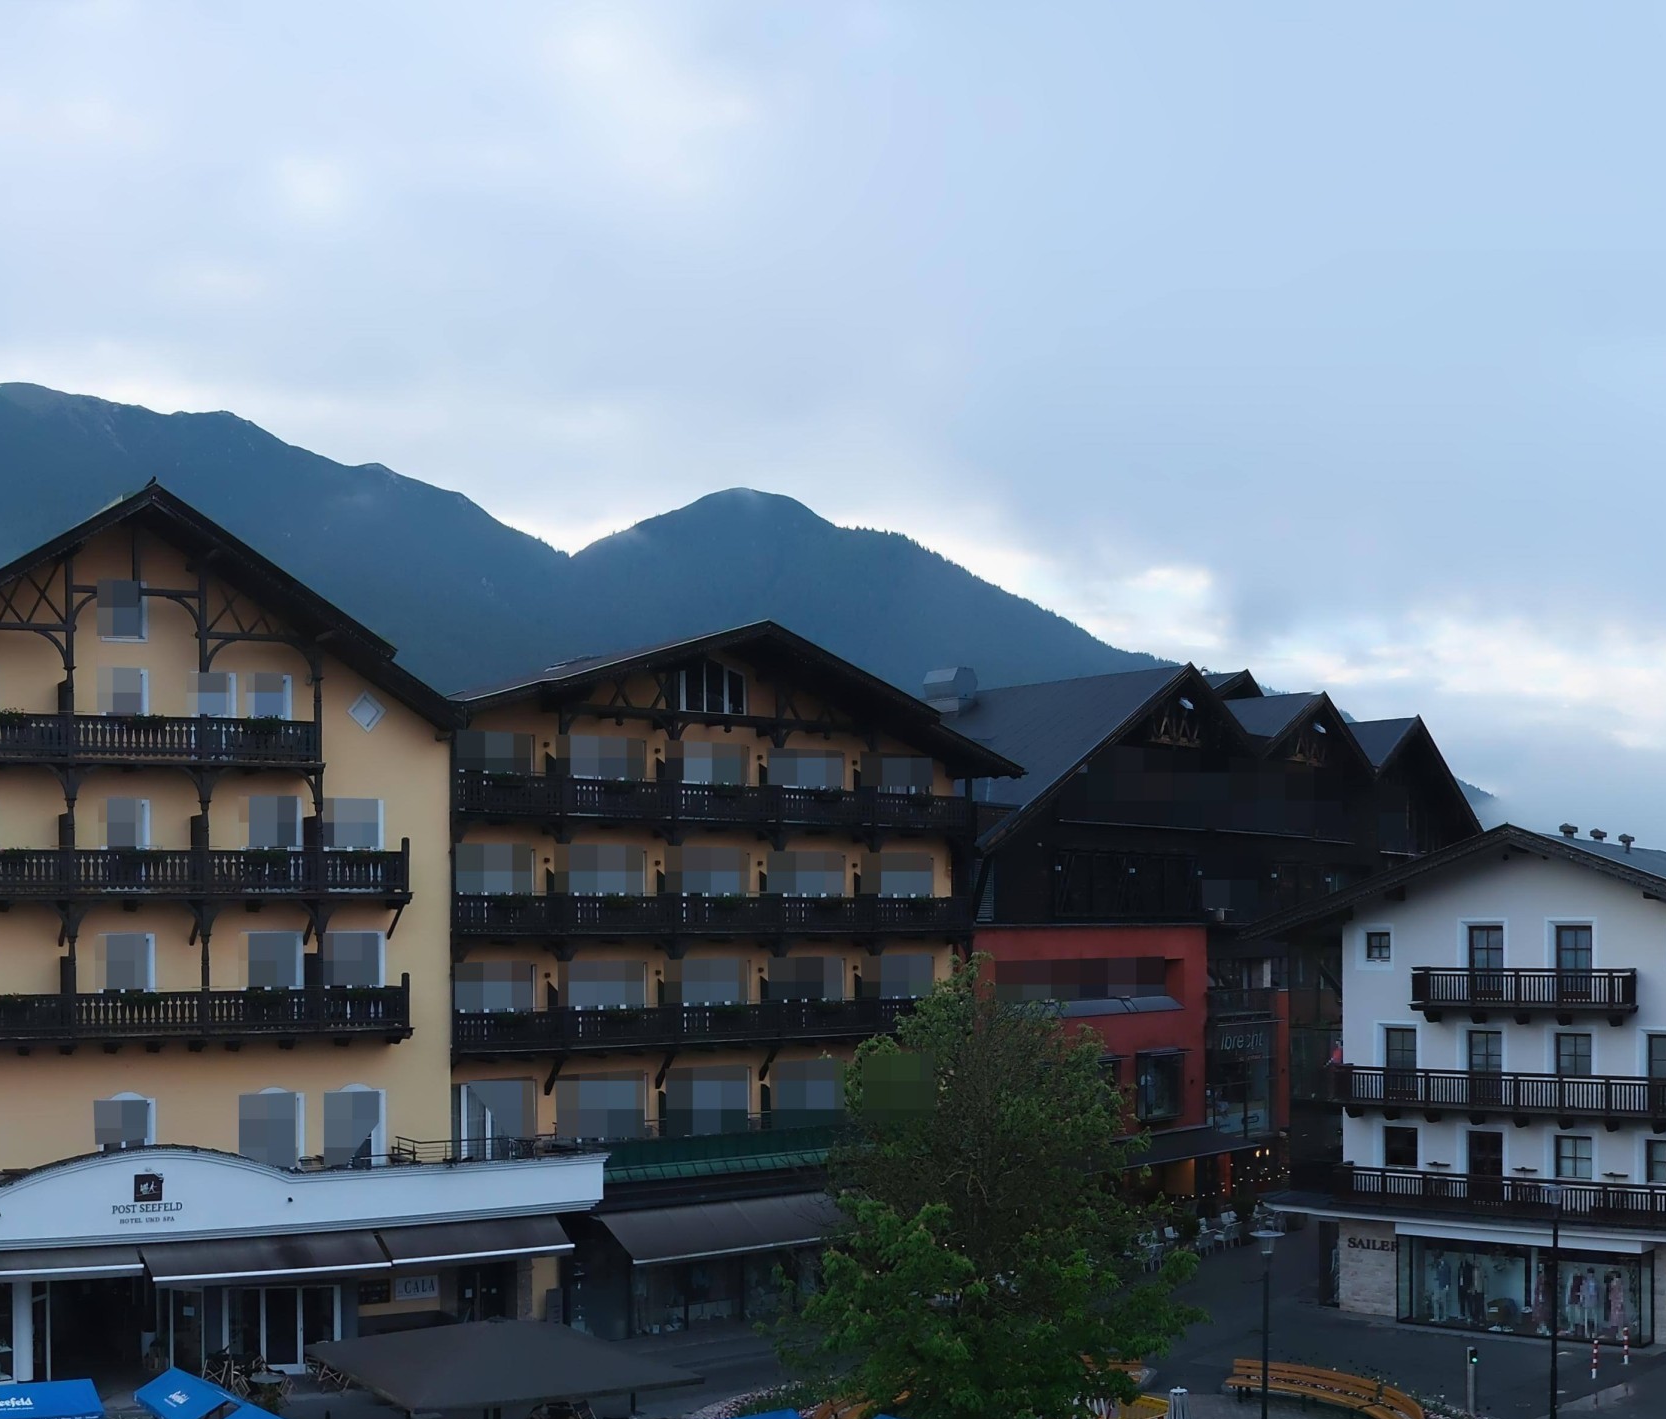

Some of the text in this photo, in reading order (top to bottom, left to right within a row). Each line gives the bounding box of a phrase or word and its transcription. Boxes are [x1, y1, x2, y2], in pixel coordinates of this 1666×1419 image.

[112, 1202, 183, 1214] POST SEEFELD
[405, 1279, 435, 1294] CALA
